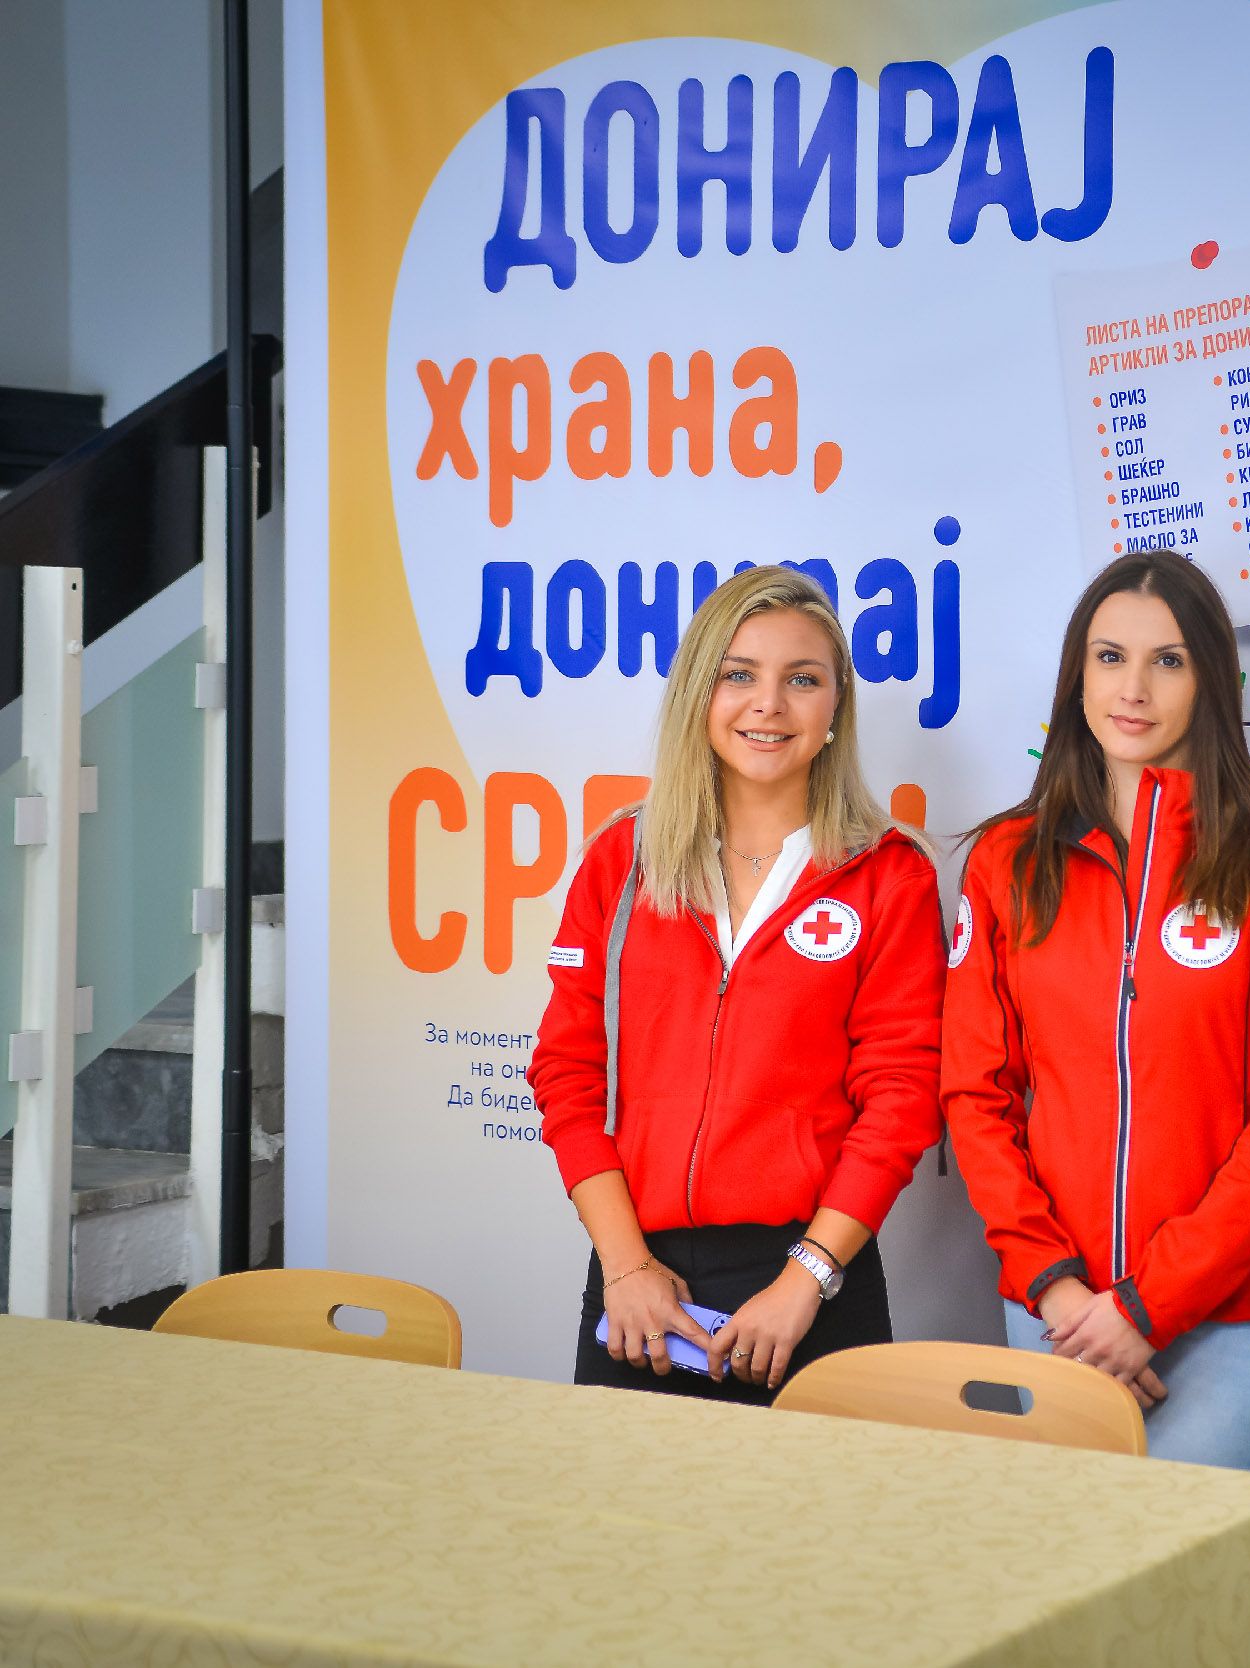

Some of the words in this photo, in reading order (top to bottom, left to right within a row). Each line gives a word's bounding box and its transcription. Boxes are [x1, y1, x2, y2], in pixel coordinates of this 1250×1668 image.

[484, 46, 1114, 293] ДОНИРАЈ
[1086, 318, 1142, 346] ЛИСТА
[1146, 313, 1170, 336] НА
[1088, 344, 1170, 376] АРТИКЛИ
[1172, 339, 1198, 363] ЗА
[1109, 388, 1147, 409] ОРИЗ
[416, 346, 843, 528] храна,
[1112, 412, 1147, 434] ГРАВ
[1115, 437, 1144, 458] СОЛ
[1118, 457, 1166, 482] ШЕЌЕР
[1121, 481, 1180, 506] БРАШНО
[1123, 501, 1204, 529] ТЕСТЕНИНИ
[1126, 531, 1177, 554] МАСЛО
[1180, 527, 1199, 545] ЗА
[466, 516, 961, 729] донај
[425, 1022, 448, 1044] За
[456, 1030, 533, 1050] момент
[471, 1061, 494, 1077] на
[501, 1063, 527, 1080] он
[447, 1084, 473, 1108] Да
[481, 1086, 537, 1114] биде
